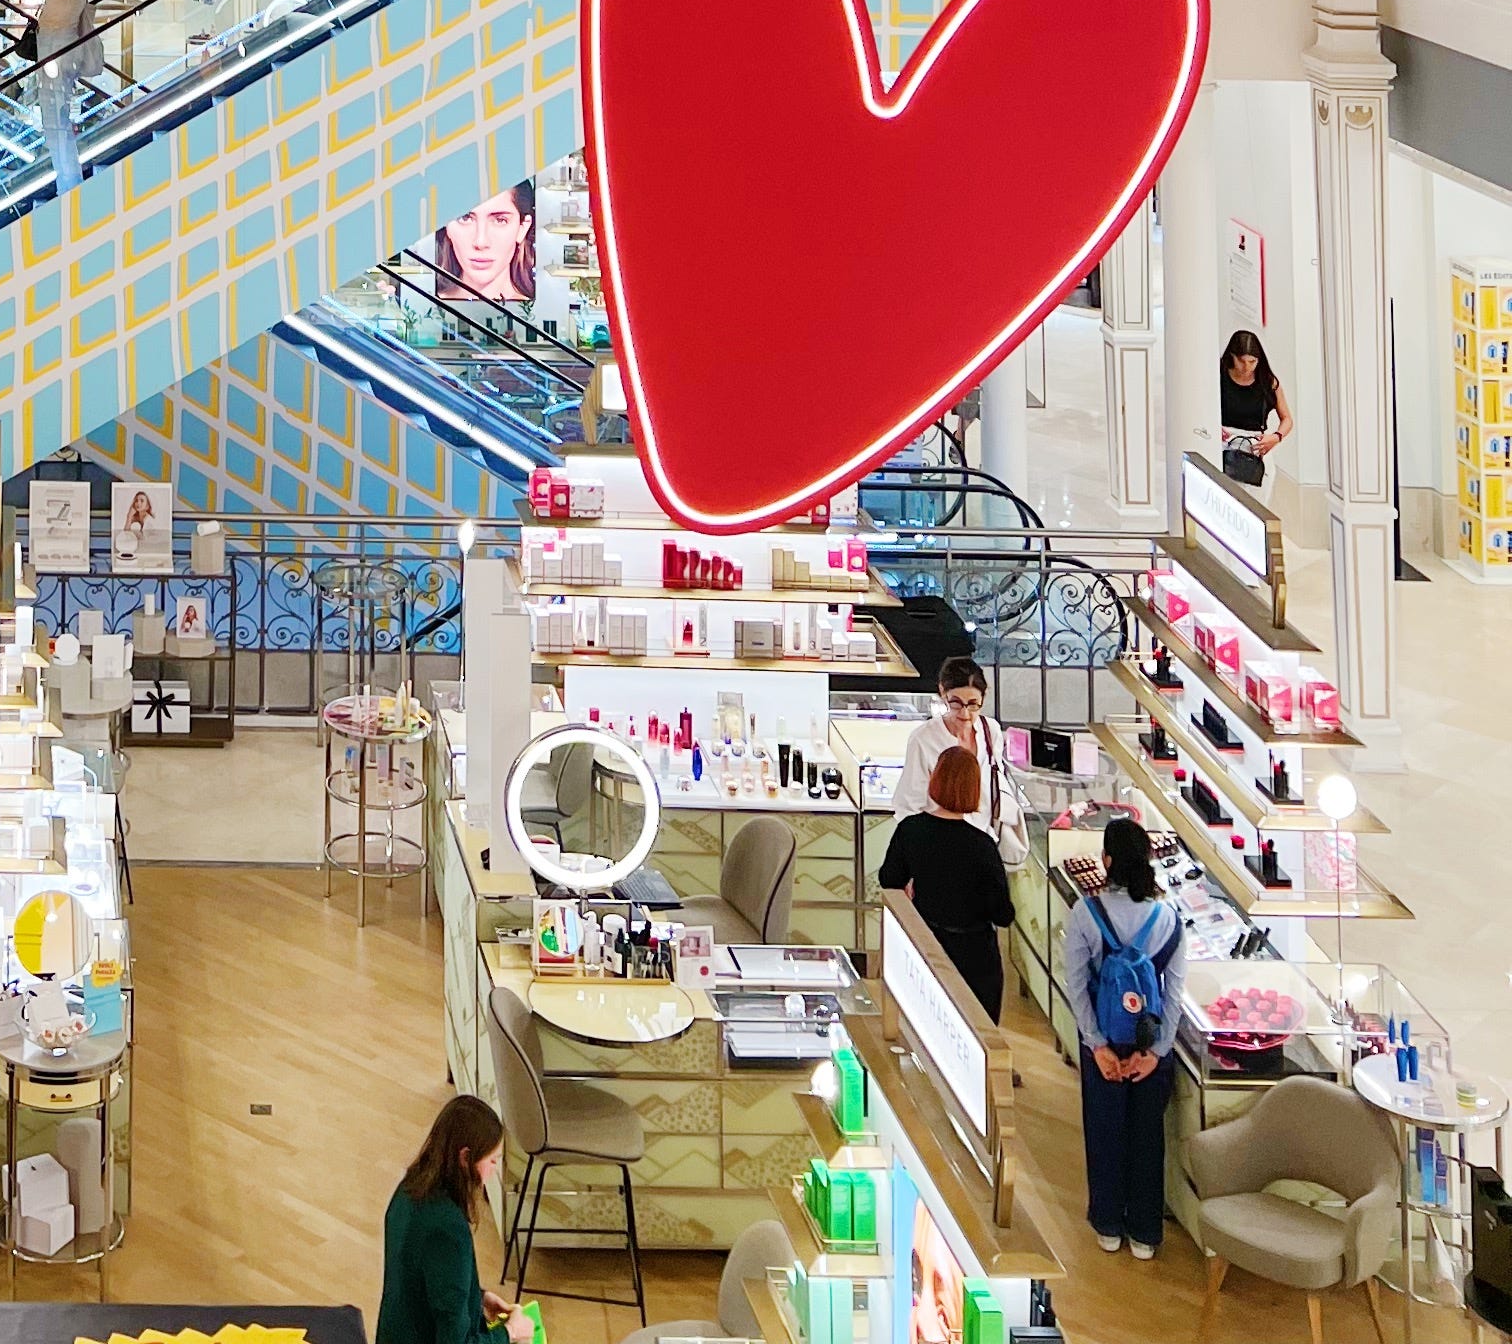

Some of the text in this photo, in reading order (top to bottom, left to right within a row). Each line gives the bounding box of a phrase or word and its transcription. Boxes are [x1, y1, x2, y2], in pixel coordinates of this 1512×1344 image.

[1201, 487, 1250, 538] SHISEIDO
[903, 949, 970, 1073] TATA HARPER
